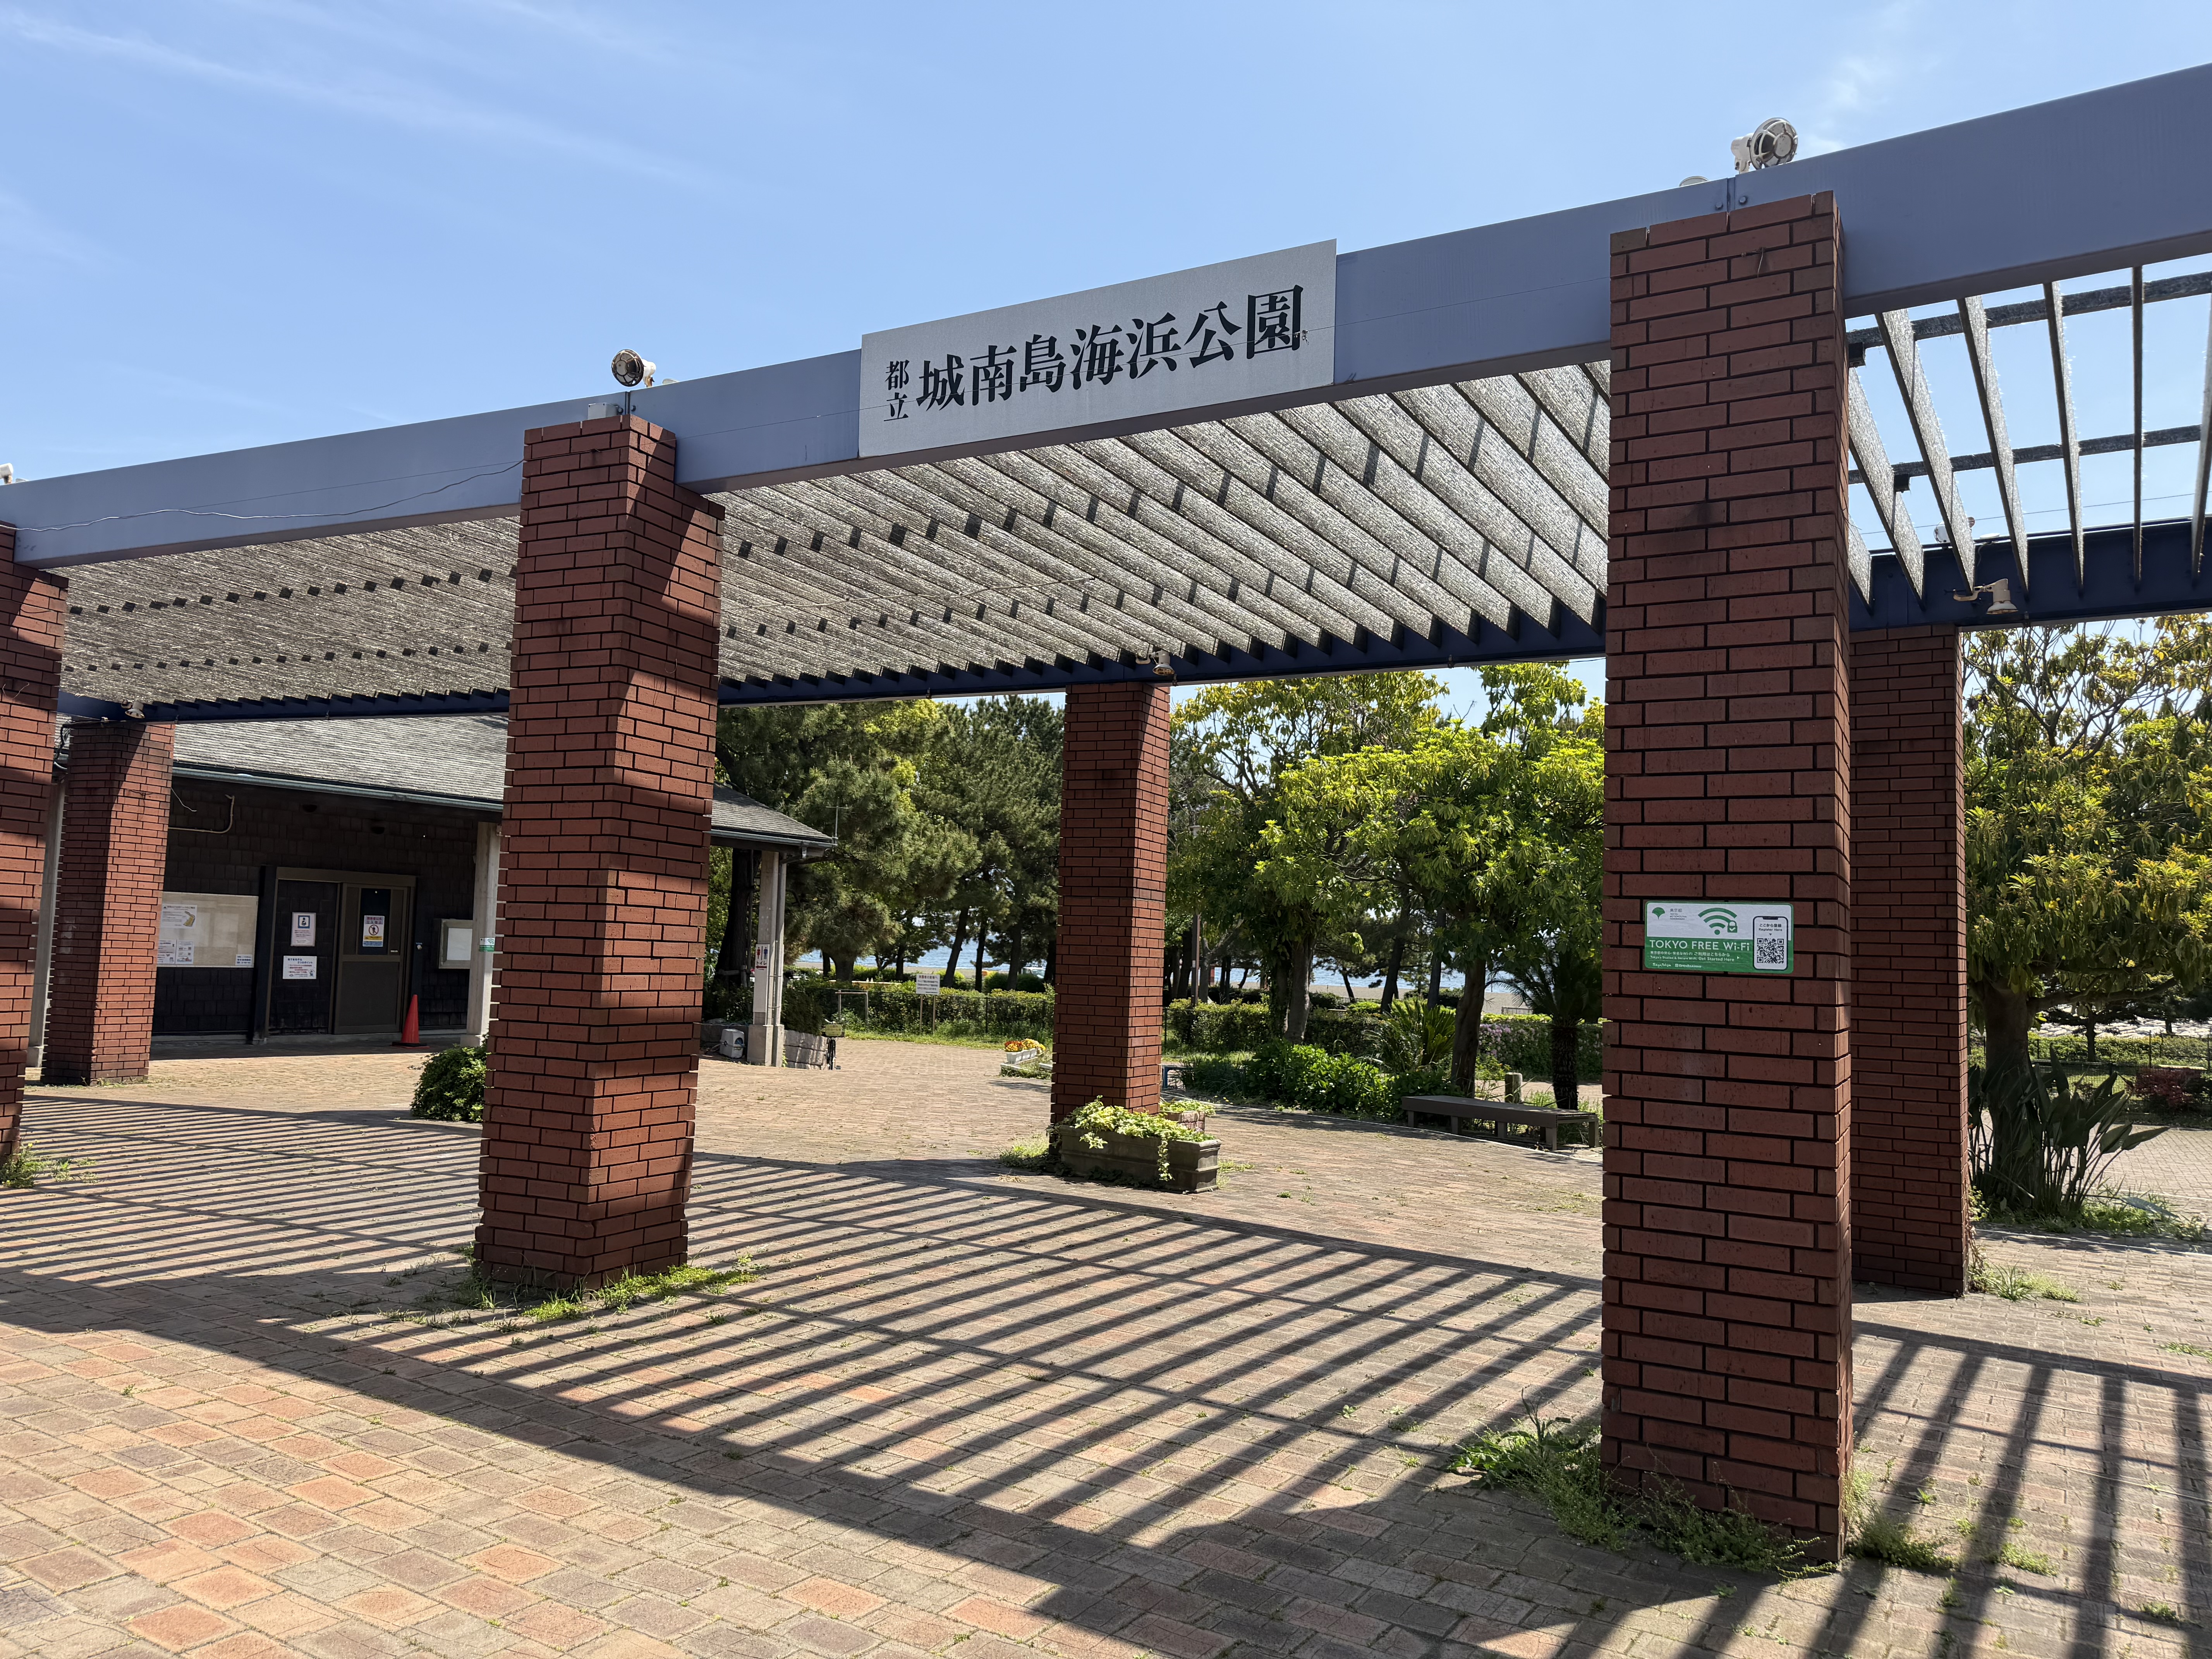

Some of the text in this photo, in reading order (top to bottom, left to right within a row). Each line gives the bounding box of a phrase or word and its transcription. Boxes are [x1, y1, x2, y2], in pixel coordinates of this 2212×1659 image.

[916, 285, 1303, 411] 城南島海浜公園
[883, 359, 909, 421] 都立
[1649, 940, 1750, 951] TOKYO FREE Wi-Fi
